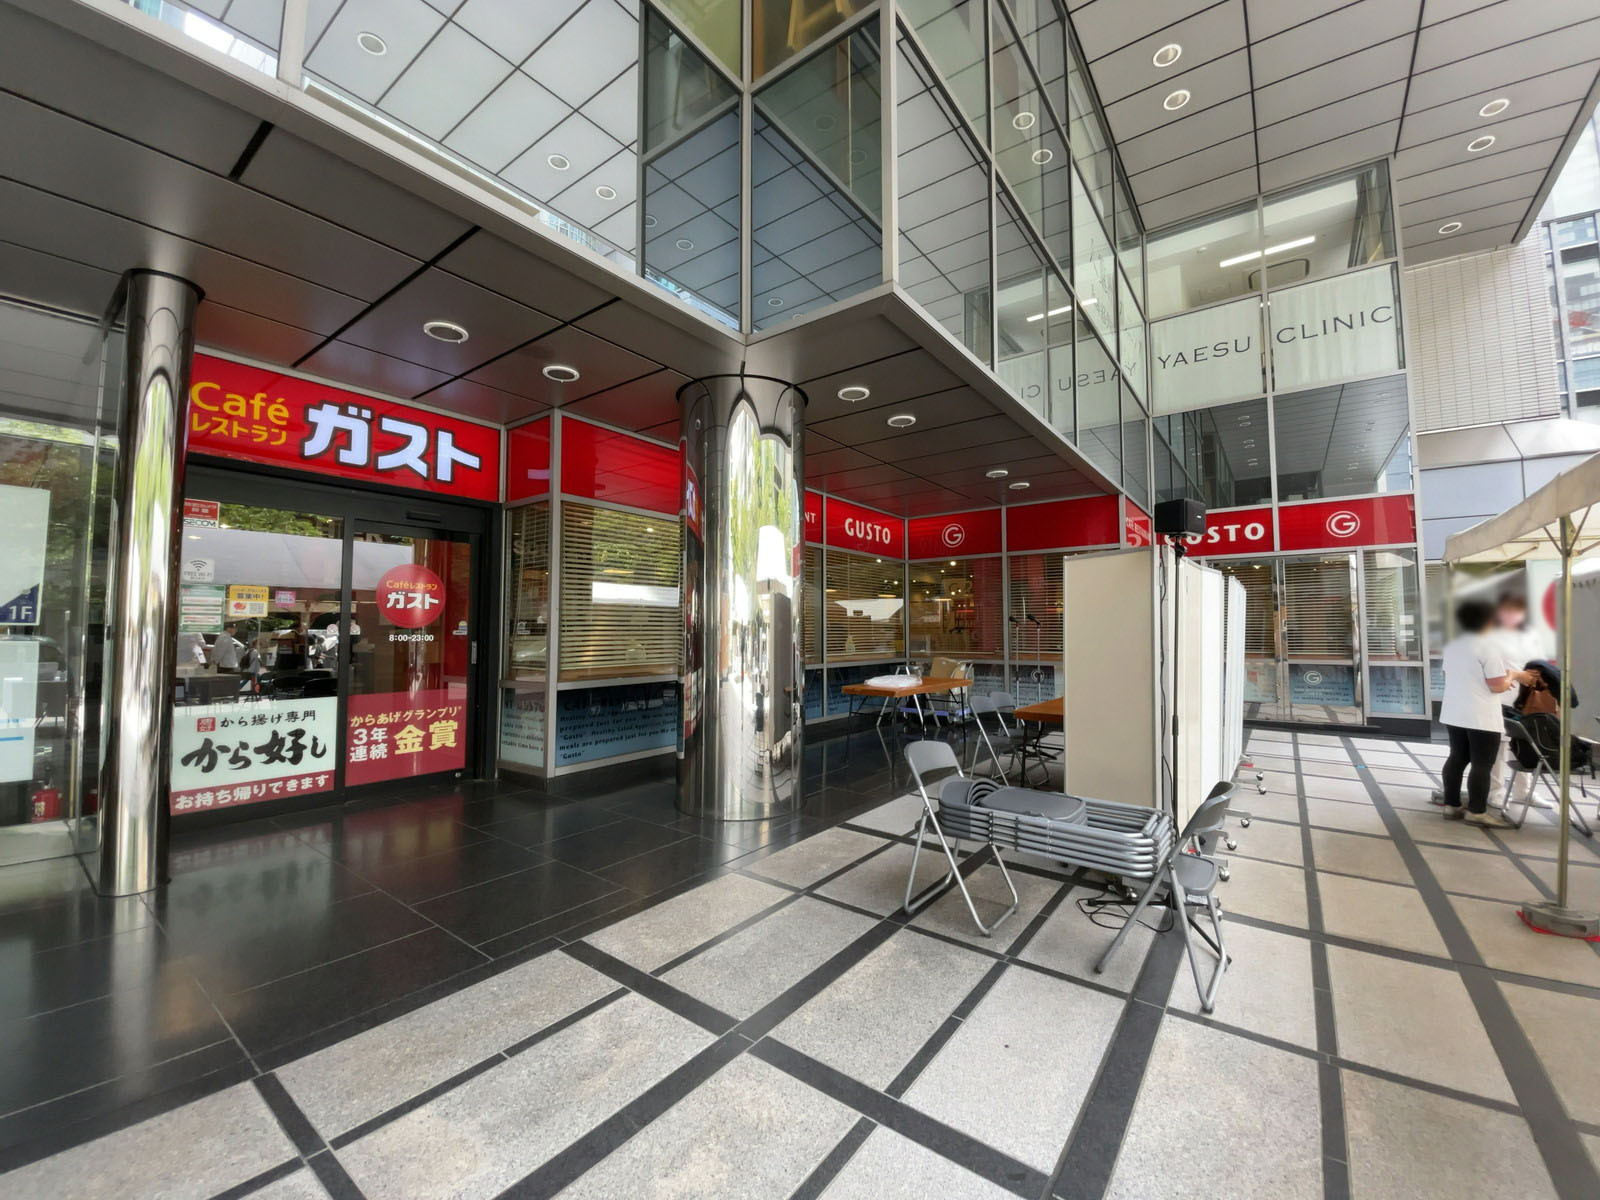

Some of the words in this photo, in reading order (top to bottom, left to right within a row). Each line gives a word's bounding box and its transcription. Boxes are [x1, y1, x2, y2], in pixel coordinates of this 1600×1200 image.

[1157, 336, 1252, 370] YAESU
[1276, 306, 1393, 345] CLINIC
[190, 381, 290, 425] Café
[191, 413, 288, 446] レストラン
[302, 402, 482, 483] ガスト
[844, 517, 892, 545] GUSTO
[9, 605, 33, 621] 1F
[386, 591, 440, 610] ガスト
[220, 709, 317, 728] から揚げ専門
[180, 728, 327, 773] から好し
[352, 727, 389, 746] 3年
[393, 719, 459, 756] 金賞
[349, 743, 388, 764] 連続
[174, 774, 330, 811] お持ち帰りできます
